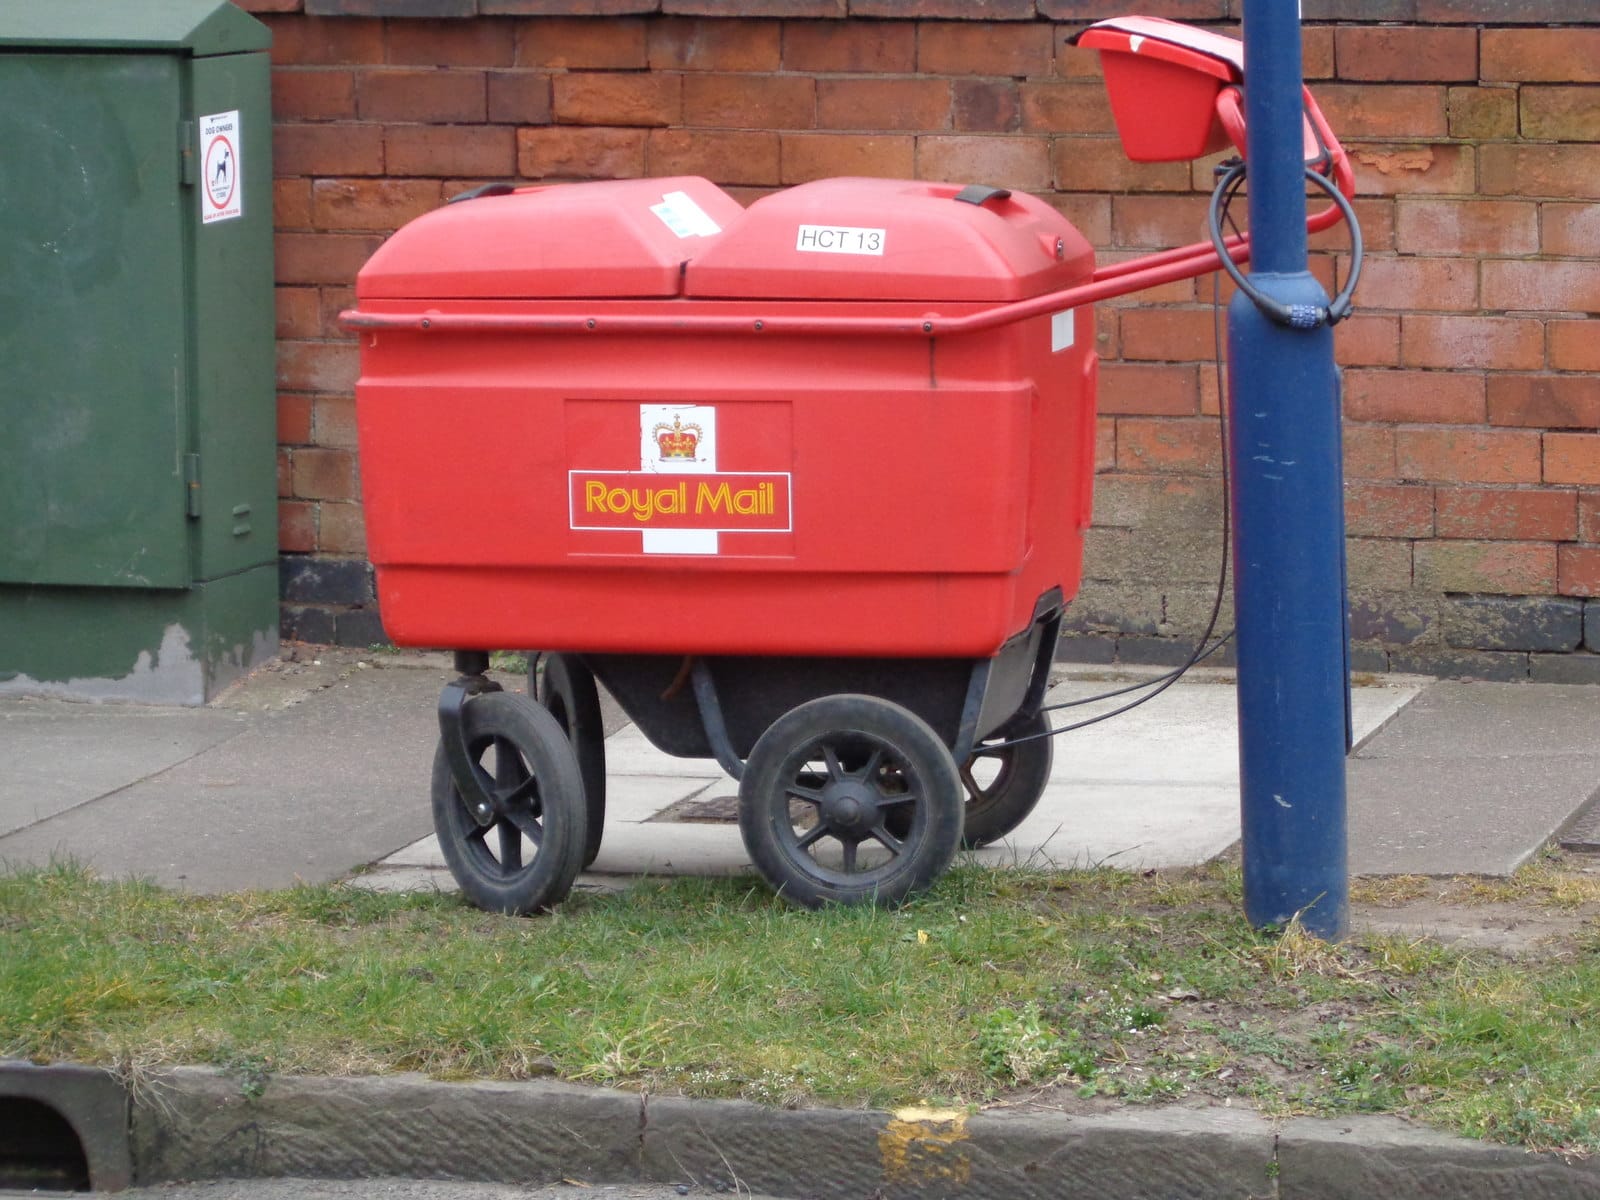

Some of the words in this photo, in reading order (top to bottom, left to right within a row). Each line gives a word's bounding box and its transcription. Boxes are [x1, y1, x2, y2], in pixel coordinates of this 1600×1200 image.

[205, 126, 215, 135] DOG
[801, 229, 850, 249] HCT
[857, 231, 881, 251] 13
[585, 480, 687, 522] Royal
[694, 481, 775, 515] Mail
